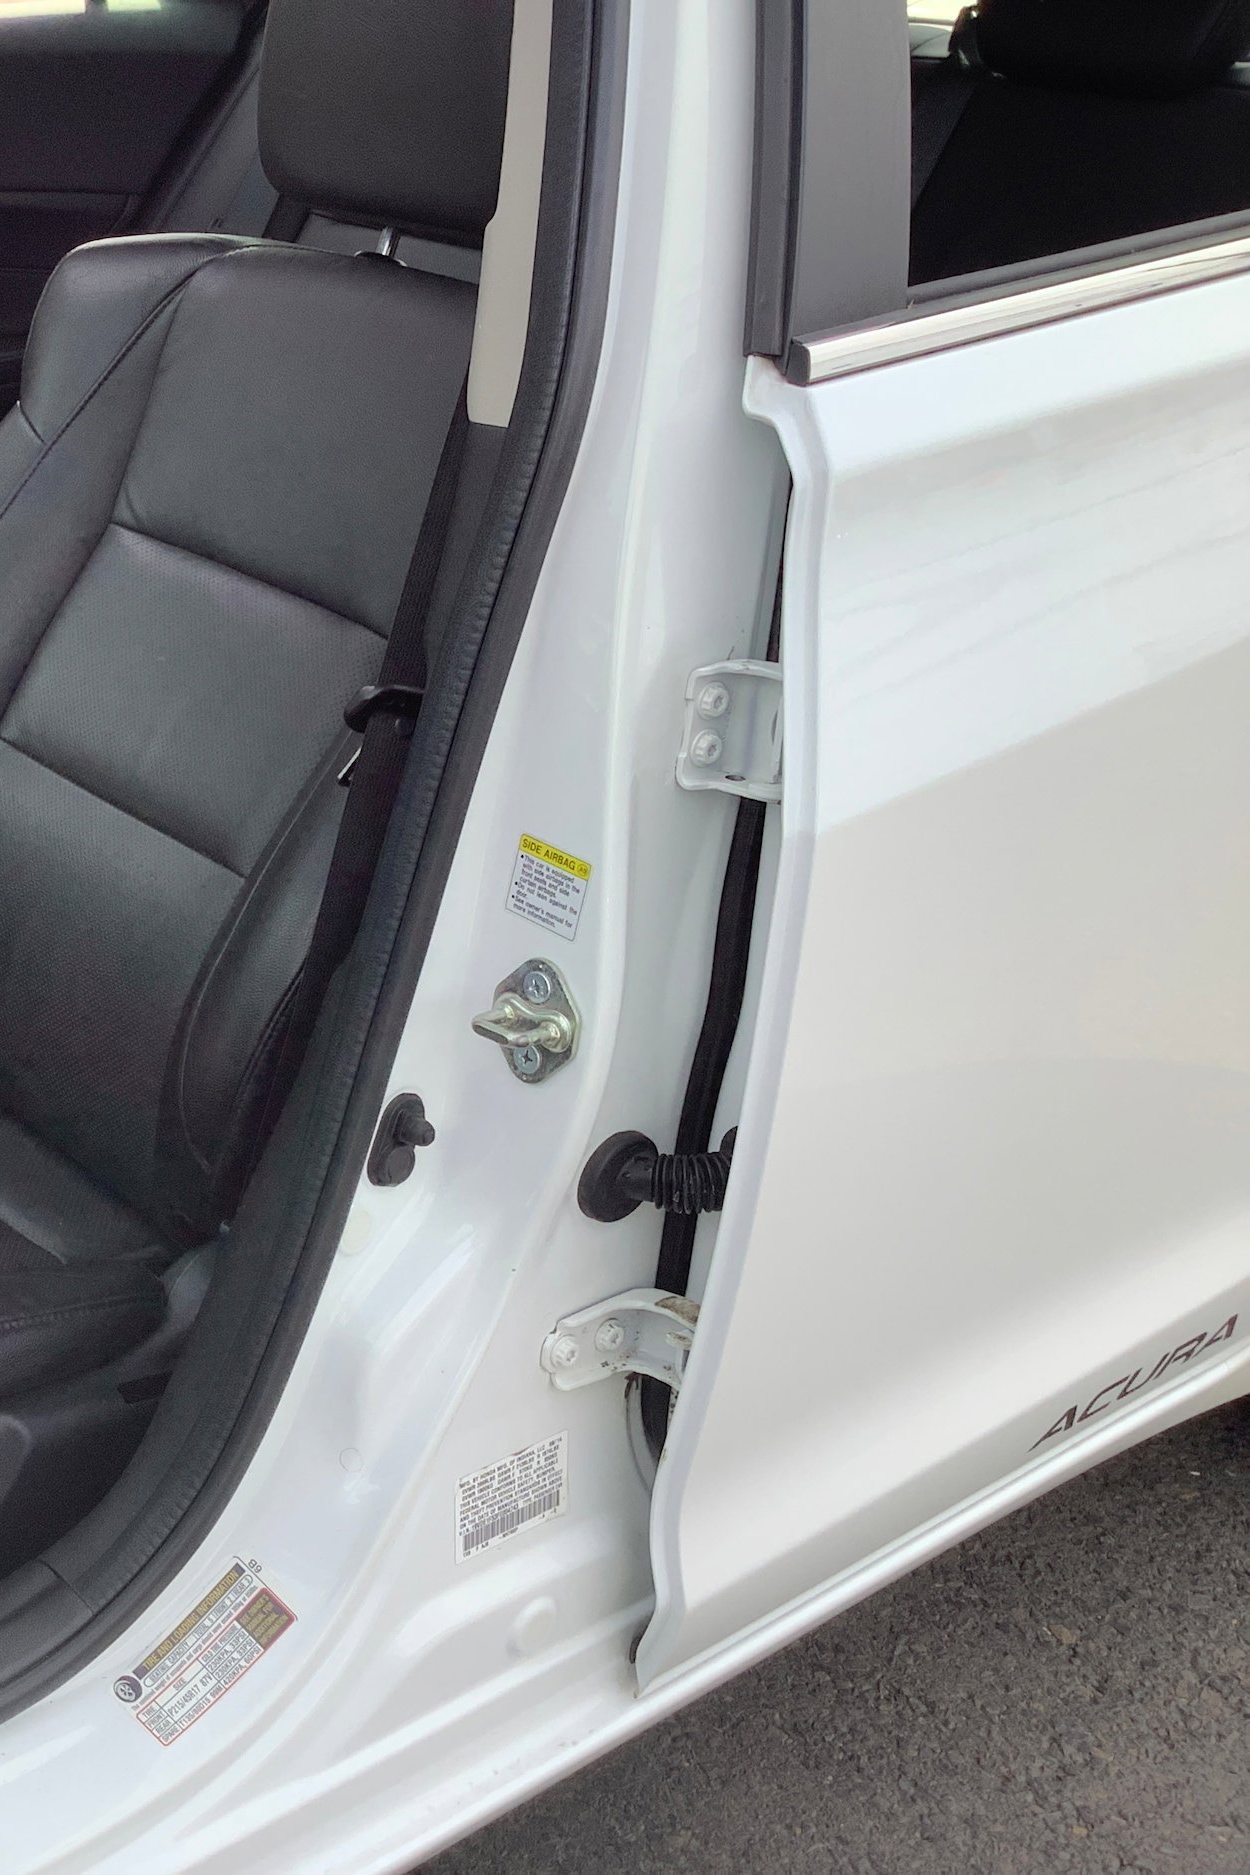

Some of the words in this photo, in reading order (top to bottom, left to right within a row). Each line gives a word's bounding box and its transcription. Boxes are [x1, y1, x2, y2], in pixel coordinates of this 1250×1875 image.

[521, 838, 542, 854] SIDE
[543, 848, 576, 870] AIRBAG
[524, 854, 534, 864] This
[535, 861, 544, 869] car
[551, 868, 574, 883] equipped
[519, 876, 536, 888] curtain
[521, 868, 532, 878] front
[533, 875, 546, 885] seats
[547, 881, 557, 890] and
[558, 887, 569, 896] side
[522, 862, 532, 871] with
[534, 868, 544, 876] side
[545, 873, 563, 886] airbags
[571, 885, 580, 893] the
[513, 903, 525, 912] more
[515, 895, 524, 904] See
[525, 900, 544, 914] owner's
[545, 910, 564, 923] manual
[564, 920, 572, 928] for
[517, 881, 525, 890] Do
[526, 886, 534, 894] not
[536, 891, 547, 900] lean
[548, 897, 567, 911] against
[568, 906, 577, 915] the
[1027, 1314, 1238, 1452] ACURA
[141, 1652, 160, 1670] TIRE
[155, 1638, 173, 1656] AND
[168, 1611, 200, 1642] LOADING
[193, 1569, 241, 1614] INFORMATION
[217, 1624, 239, 1645] PRESSURE
[206, 1646, 232, 1671] 230KPA,
[228, 1630, 247, 1649] 33PSI
[214, 1654, 239, 1678] 230KPA,
[235, 1637, 255, 1656] 33PSI
[220, 1661, 247, 1686] 420KPA,
[242, 1645, 262, 1664] 60PSI
[141, 1704, 156, 1719] TIRE
[172, 1676, 186, 1690] SIZE
[166, 1683, 201, 1717] P215/45R17
[198, 1672, 213, 1687] 87V
[147, 1710, 165, 1728] FRONT
[155, 1718, 171, 1734] REAR
[161, 1725, 179, 1743] SPARE
